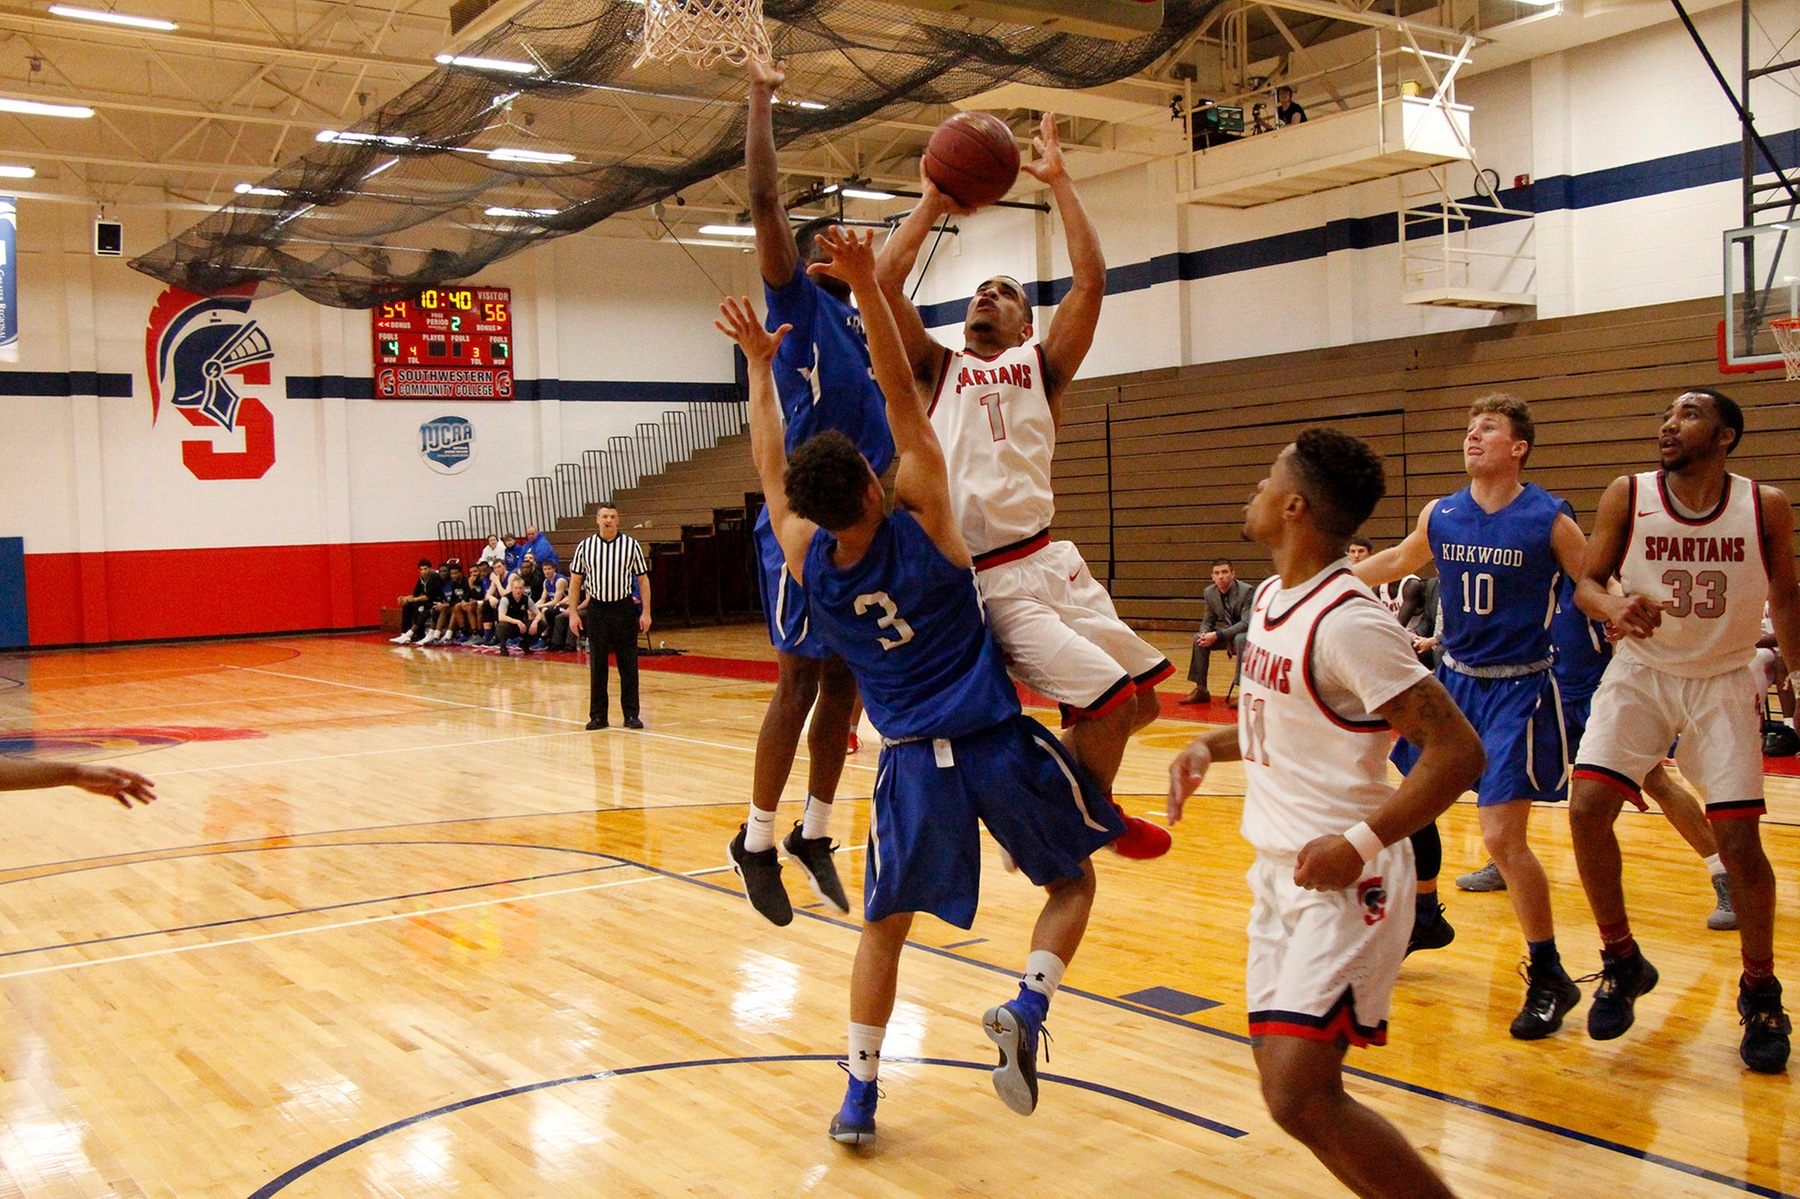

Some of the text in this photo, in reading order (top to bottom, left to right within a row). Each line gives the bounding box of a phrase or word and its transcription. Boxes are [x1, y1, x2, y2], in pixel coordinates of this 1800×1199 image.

[421, 290, 472, 310] 10:40
[477, 291, 509, 300] VISITOR
[485, 303, 506, 321] 56
[390, 321, 411, 329] BONUS
[426, 318, 449, 326] PERIOD
[451, 316, 461, 331] 2
[422, 333, 445, 341] PLAYER
[388, 341, 399, 356] 4
[410, 346, 417, 356] 4
[473, 347, 480, 358] 3
[499, 343, 508, 358] 7
[398, 368, 493, 383] SOUTHWESTERN
[398, 383, 494, 397] COMMUNITY COLLEGE
[980, 392, 1006, 442] 1
[420, 423, 473, 453] NJCAA
[1441, 543, 1523, 568] KIRKWOOD
[1645, 536, 1745, 562] SPARTANS
[1461, 571, 1494, 615] 10
[1661, 569, 1727, 619] 33
[853, 590, 915, 651] 3
[1243, 692, 1270, 767] 11
